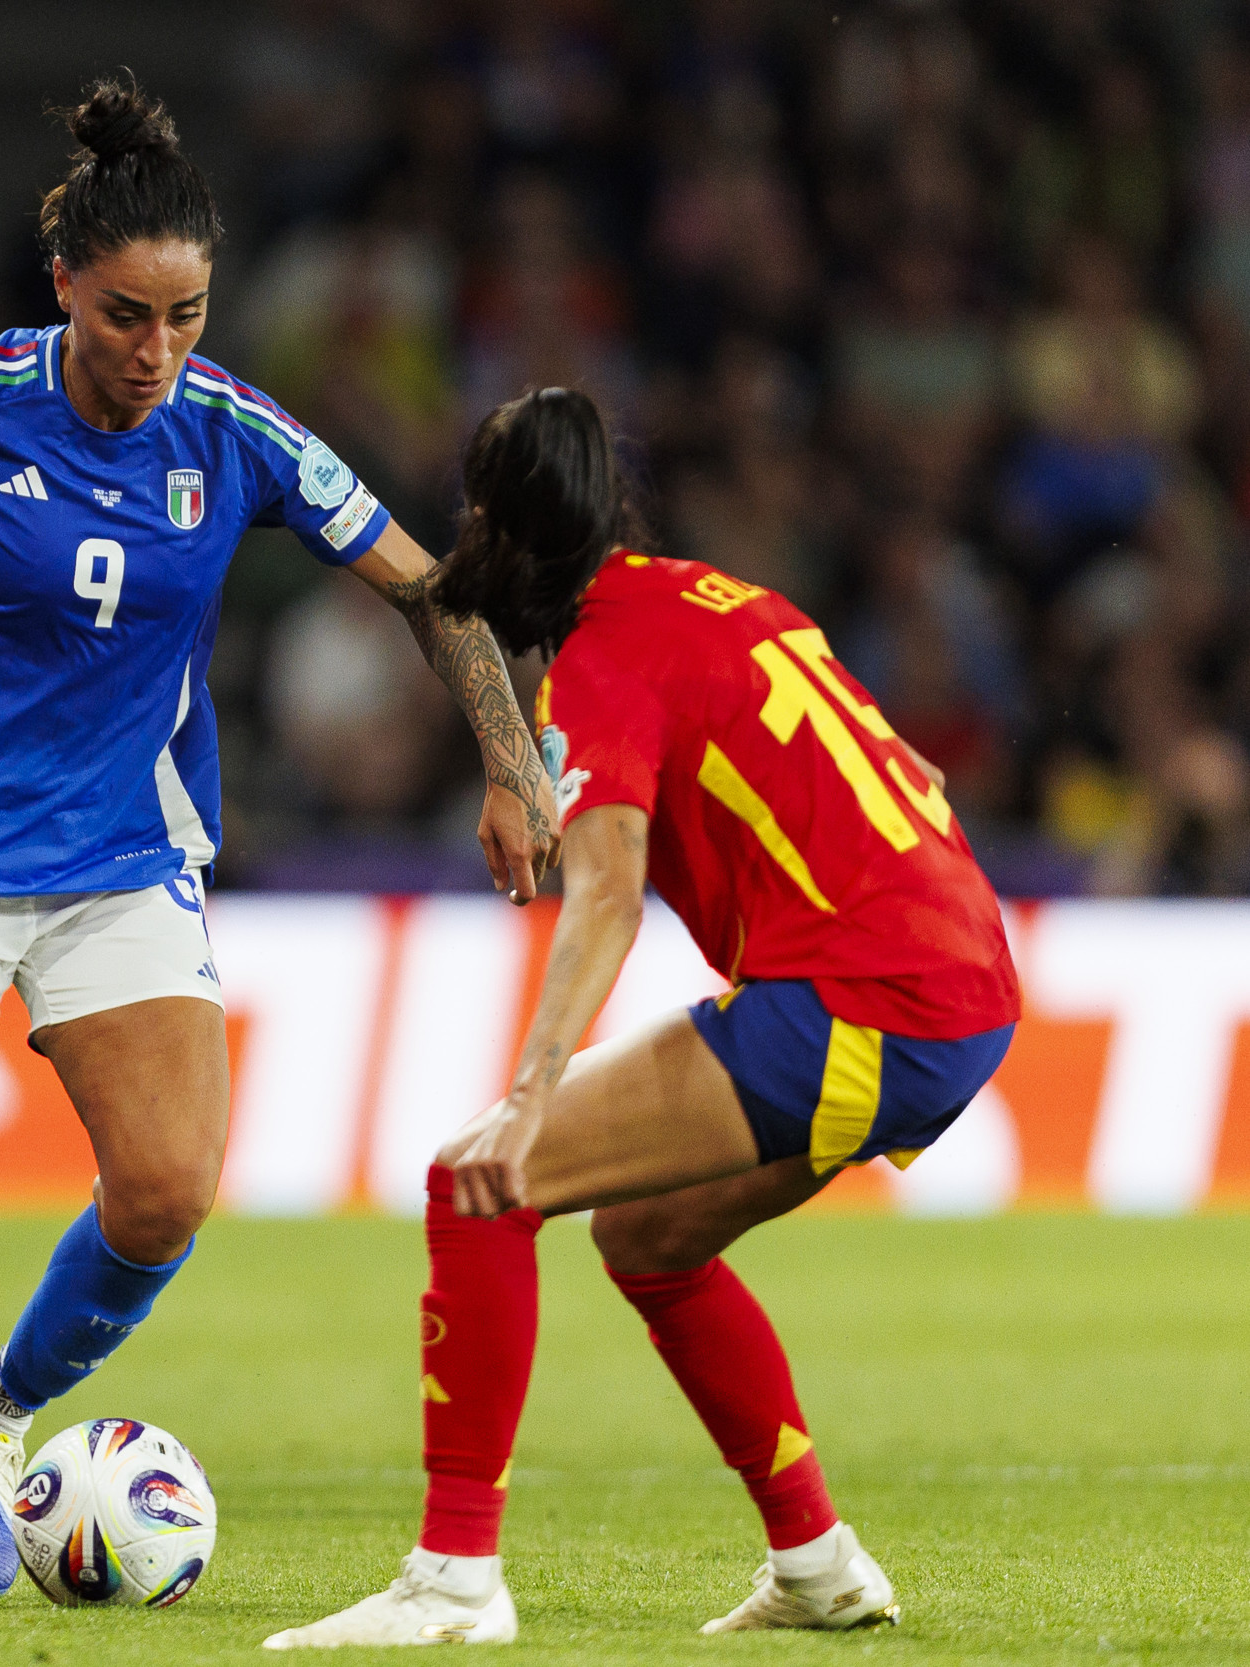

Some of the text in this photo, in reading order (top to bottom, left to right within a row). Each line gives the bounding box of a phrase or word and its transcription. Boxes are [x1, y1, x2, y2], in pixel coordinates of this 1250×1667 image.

[170, 474, 200, 486] ITALIA
[329, 497, 369, 542] FOUNDATION
[73, 537, 125, 629] 9
[749, 627, 953, 855] 15
